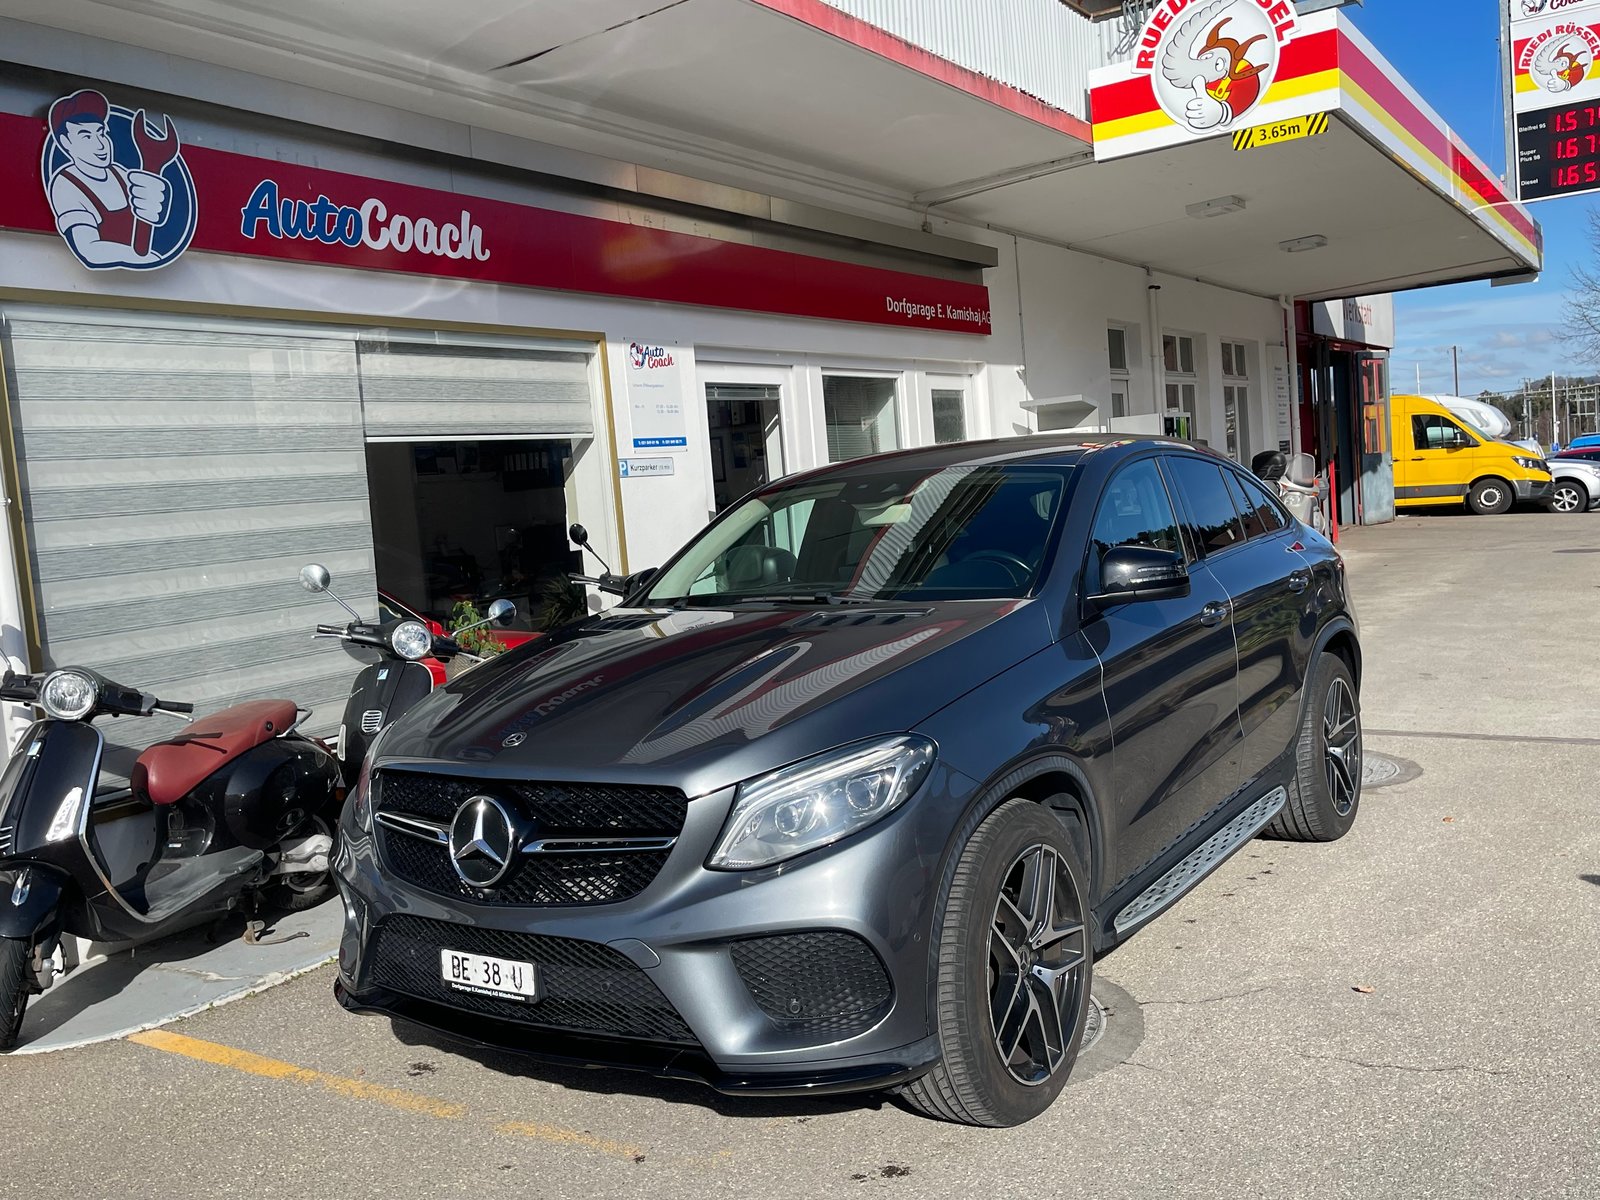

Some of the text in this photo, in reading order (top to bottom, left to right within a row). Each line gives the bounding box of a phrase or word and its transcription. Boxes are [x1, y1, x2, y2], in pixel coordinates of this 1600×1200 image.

[1136, 0, 1197, 69] RUED
[1521, 22, 1600, 67] RUEDI RÜSSEL
[1555, 107, 1600, 132] 1.57
[1259, 123, 1301, 141] 3.65m
[1519, 149, 1537, 157] Super
[1557, 134, 1600, 159] 1.67
[1520, 155, 1533, 163] Plus
[1520, 178, 1539, 187] Diesel
[886, 296, 936, 321] Dorfgarage
[937, 303, 945, 319] E.
[946, 304, 981, 326] Kamishaj
[643, 345, 664, 360] Auto
[647, 353, 675, 369] Coach
[452, 954, 471, 982] BE
[482, 961, 502, 986] 38
